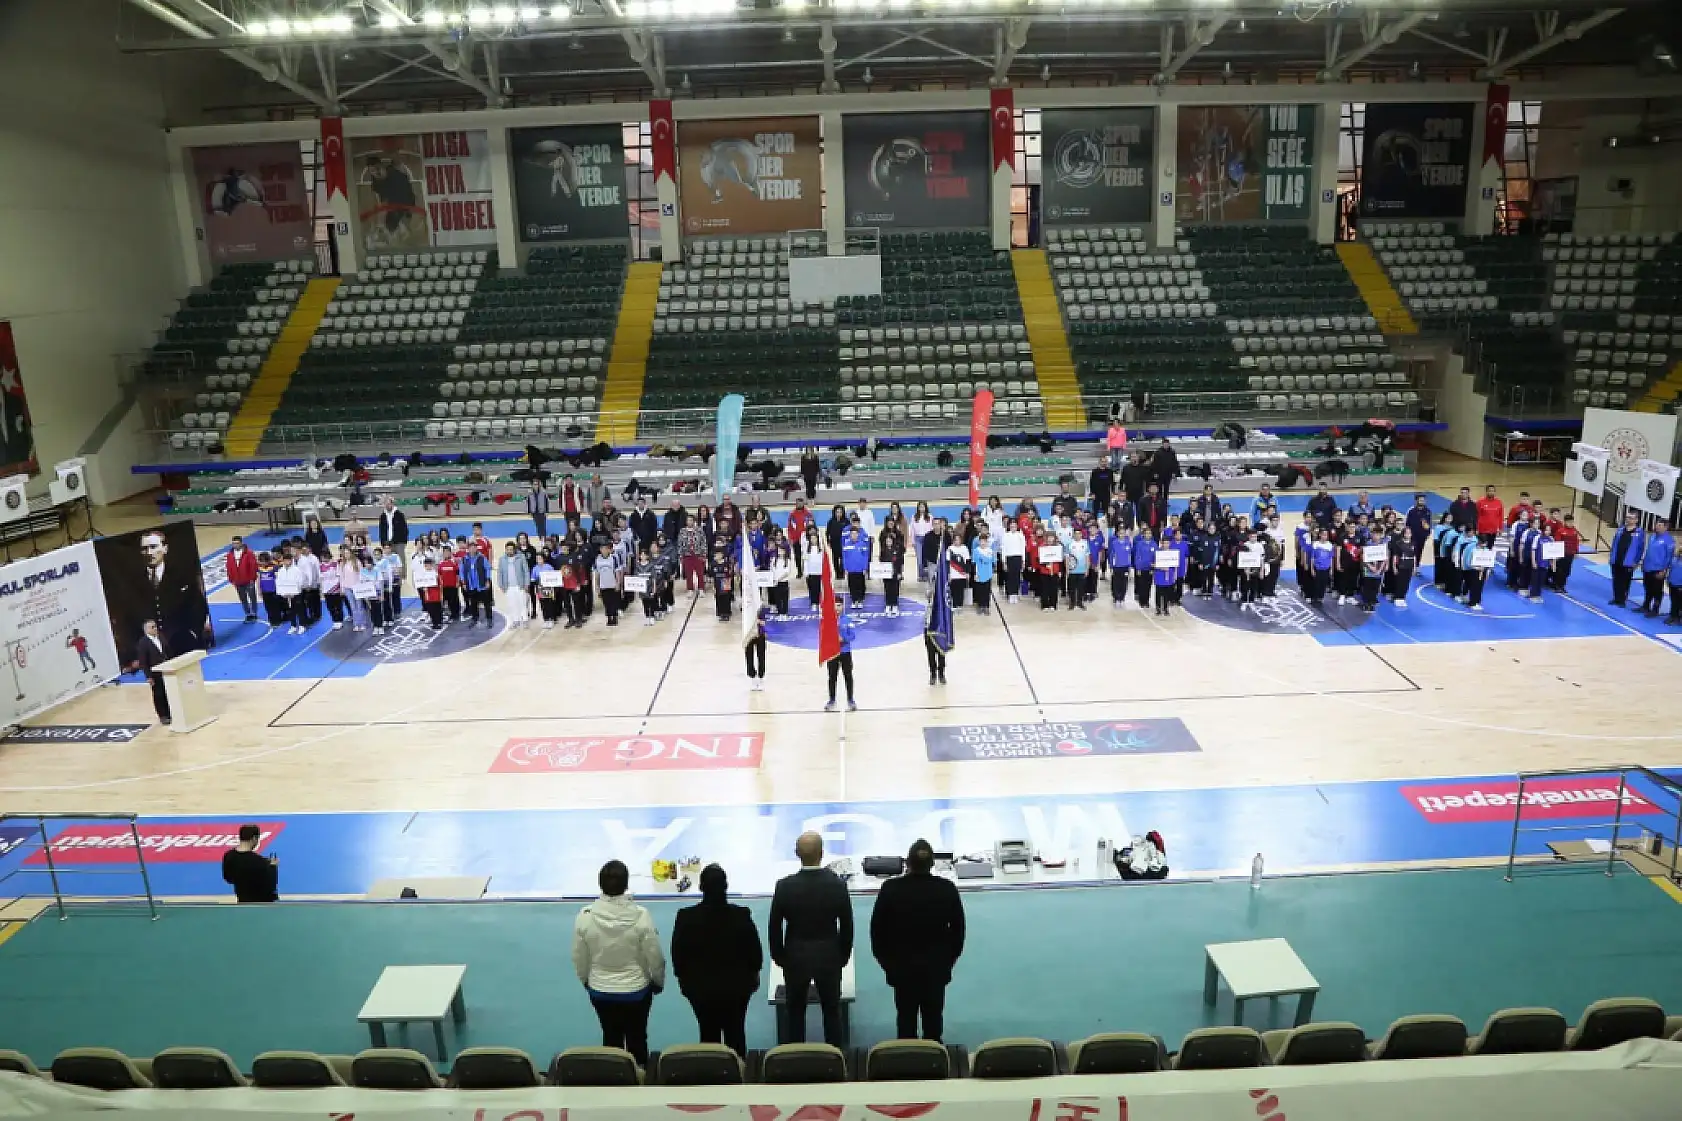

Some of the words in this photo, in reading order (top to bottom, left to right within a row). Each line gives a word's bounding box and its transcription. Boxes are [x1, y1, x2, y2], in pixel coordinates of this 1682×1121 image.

[755, 132, 796, 154] SPOR
[572, 144, 612, 165] SPOR
[577, 165, 602, 186] HER
[578, 186, 621, 207] YERDE
[758, 178, 803, 201] YERDE
[615, 737, 759, 760] ING
